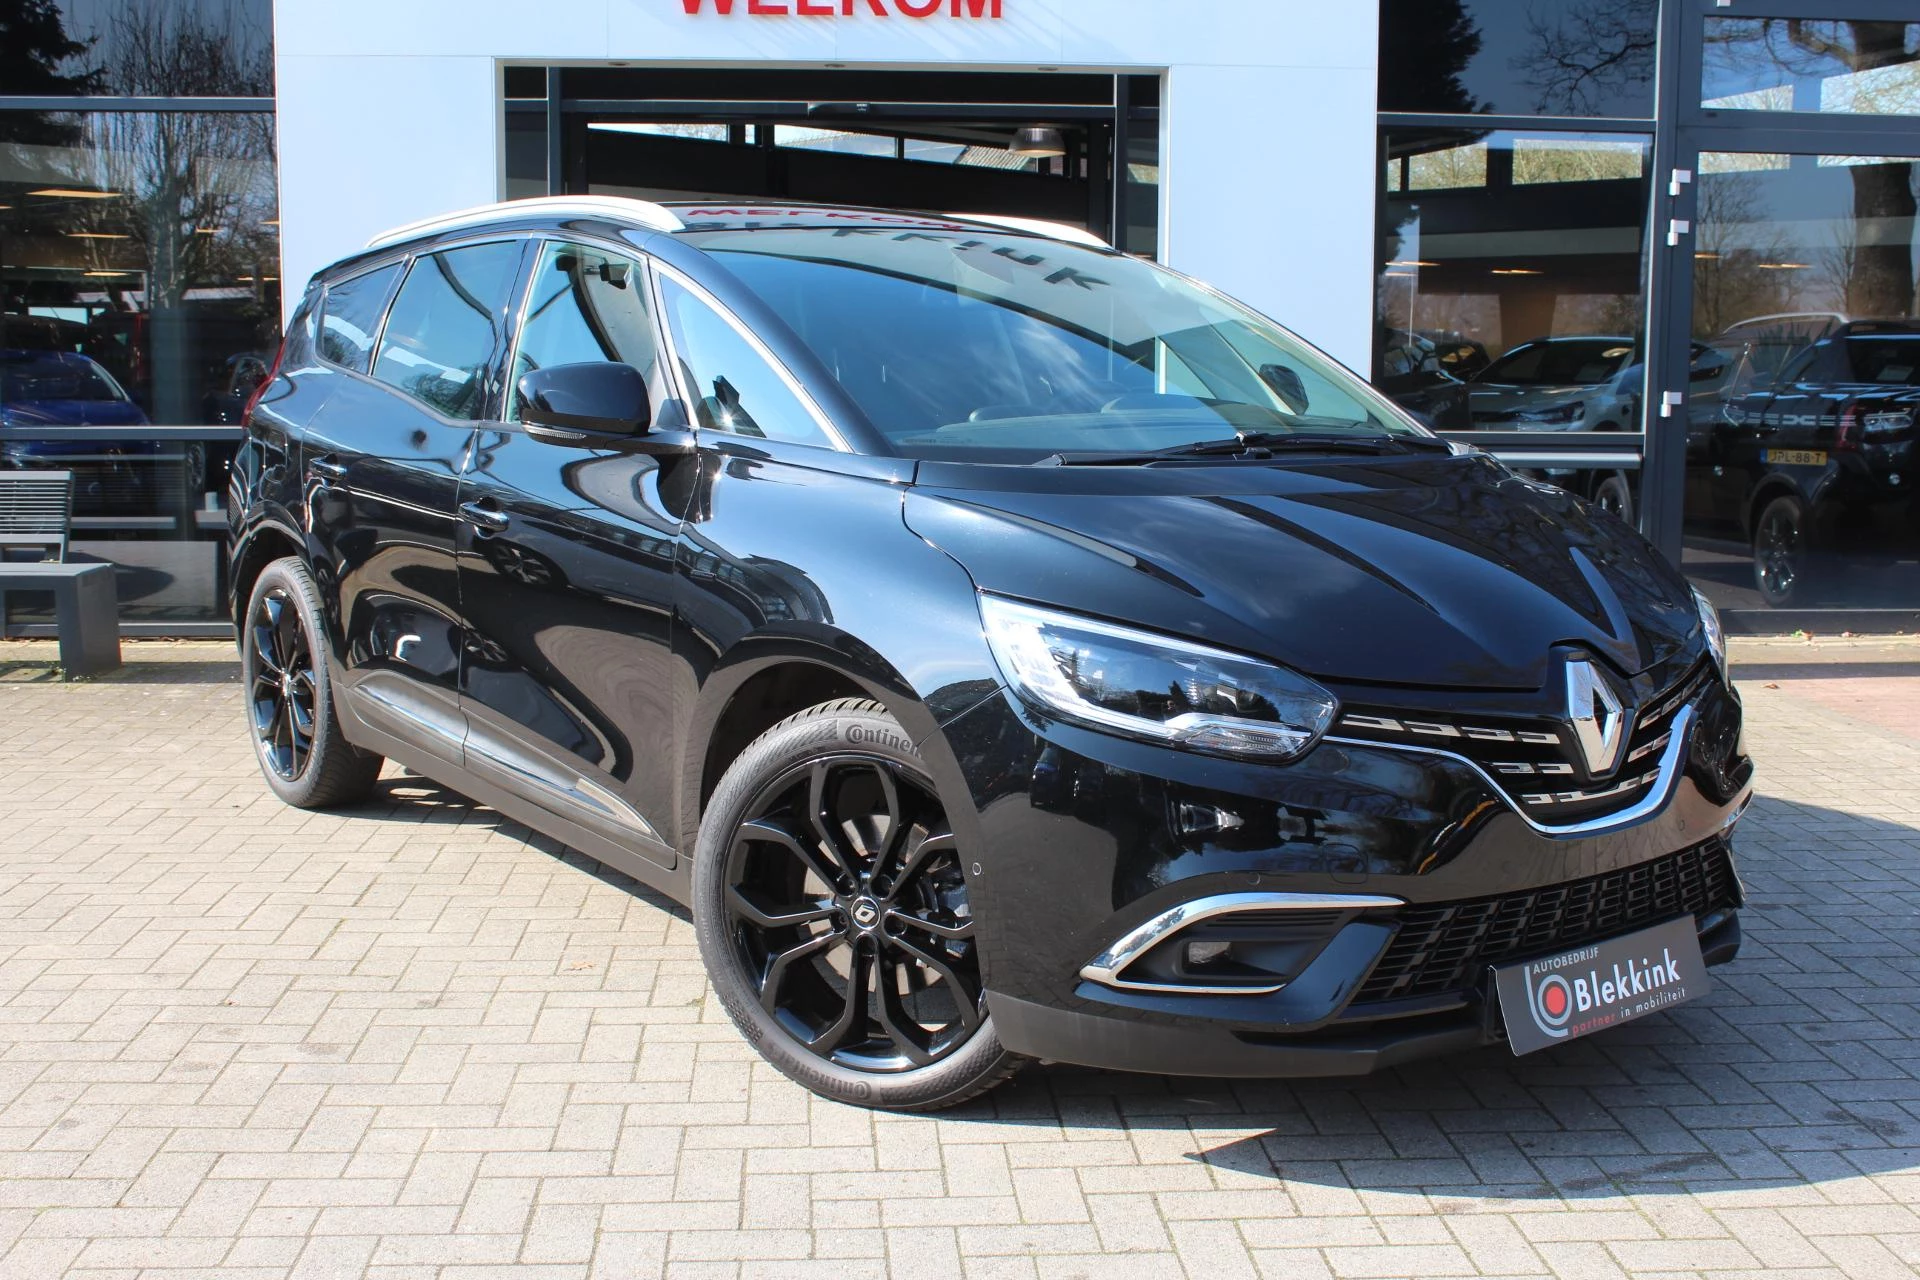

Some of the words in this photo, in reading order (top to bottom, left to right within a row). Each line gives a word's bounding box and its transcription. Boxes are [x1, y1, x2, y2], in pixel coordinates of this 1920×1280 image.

[1533, 947, 1600, 975] AUTOBEDRIJF
[1573, 948, 1681, 1013] Blekkink
[1572, 1013, 1617, 1038] partner
[1620, 1006, 1631, 1019] in
[1636, 987, 1686, 1014] mobiliteit
